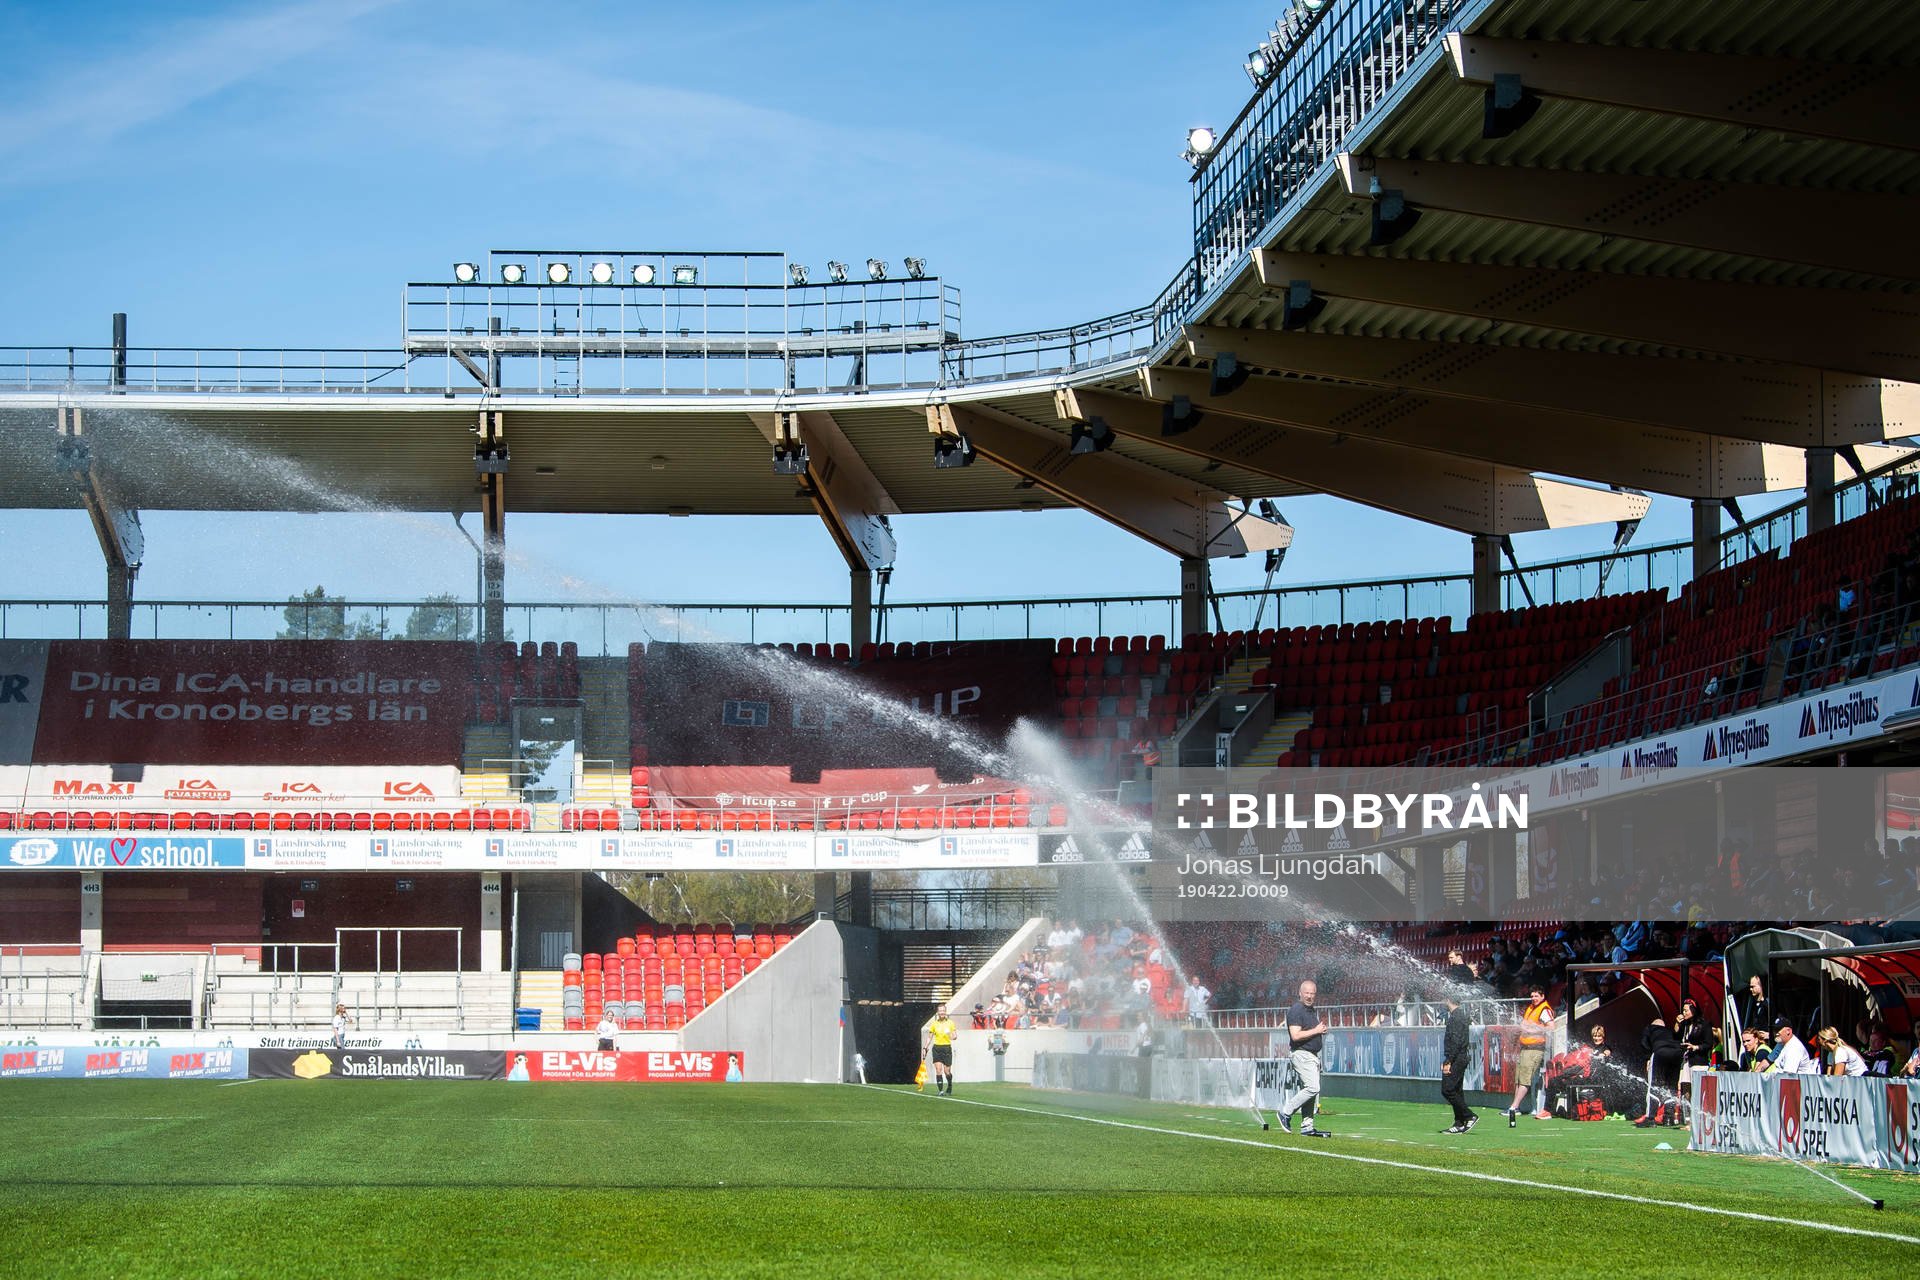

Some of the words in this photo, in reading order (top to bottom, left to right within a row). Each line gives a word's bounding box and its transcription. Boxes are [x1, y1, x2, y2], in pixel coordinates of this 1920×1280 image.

[70, 671, 161, 692] Dina
[176, 672, 442, 694] ICA-handlare
[85, 699, 94, 718] i
[109, 698, 353, 726] Kronobergs
[368, 699, 428, 721] län
[1818, 691, 1879, 740] Myresjöhus
[1718, 719, 1770, 763] Myresjöhus
[1634, 742, 1678, 783] Myresjöhus
[53, 780, 135, 795] MAXI
[178, 779, 217, 790] ICA
[282, 782, 322, 793] ICA
[384, 781, 433, 795] ICA
[1560, 763, 1599, 800] Myresjöhus
[167, 791, 228, 799] KVANTUM
[262, 792, 346, 802] Supermarket
[20, 843, 50, 859] IST
[73, 840, 105, 866] We
[140, 839, 219, 866] school.
[1118, 849, 1150, 860] adidas
[1327, 839, 1351, 850] adidas
[1052, 851, 1084, 862] adidas
[260, 1037, 285, 1048] Stolt
[288, 1037, 382, 1050] träningslerantör
[342, 1055, 465, 1077] SmålandsVillan
[542, 1051, 617, 1071] EL-Vis
[648, 1051, 714, 1071] EL-Vis
[1256, 1062, 1278, 1089] CRAFT
[1719, 1091, 1761, 1118] SVENSKA
[1804, 1095, 1859, 1125] SVENSKA
[1718, 1123, 1739, 1148] SPEL
[1803, 1128, 1830, 1157] SPEL
